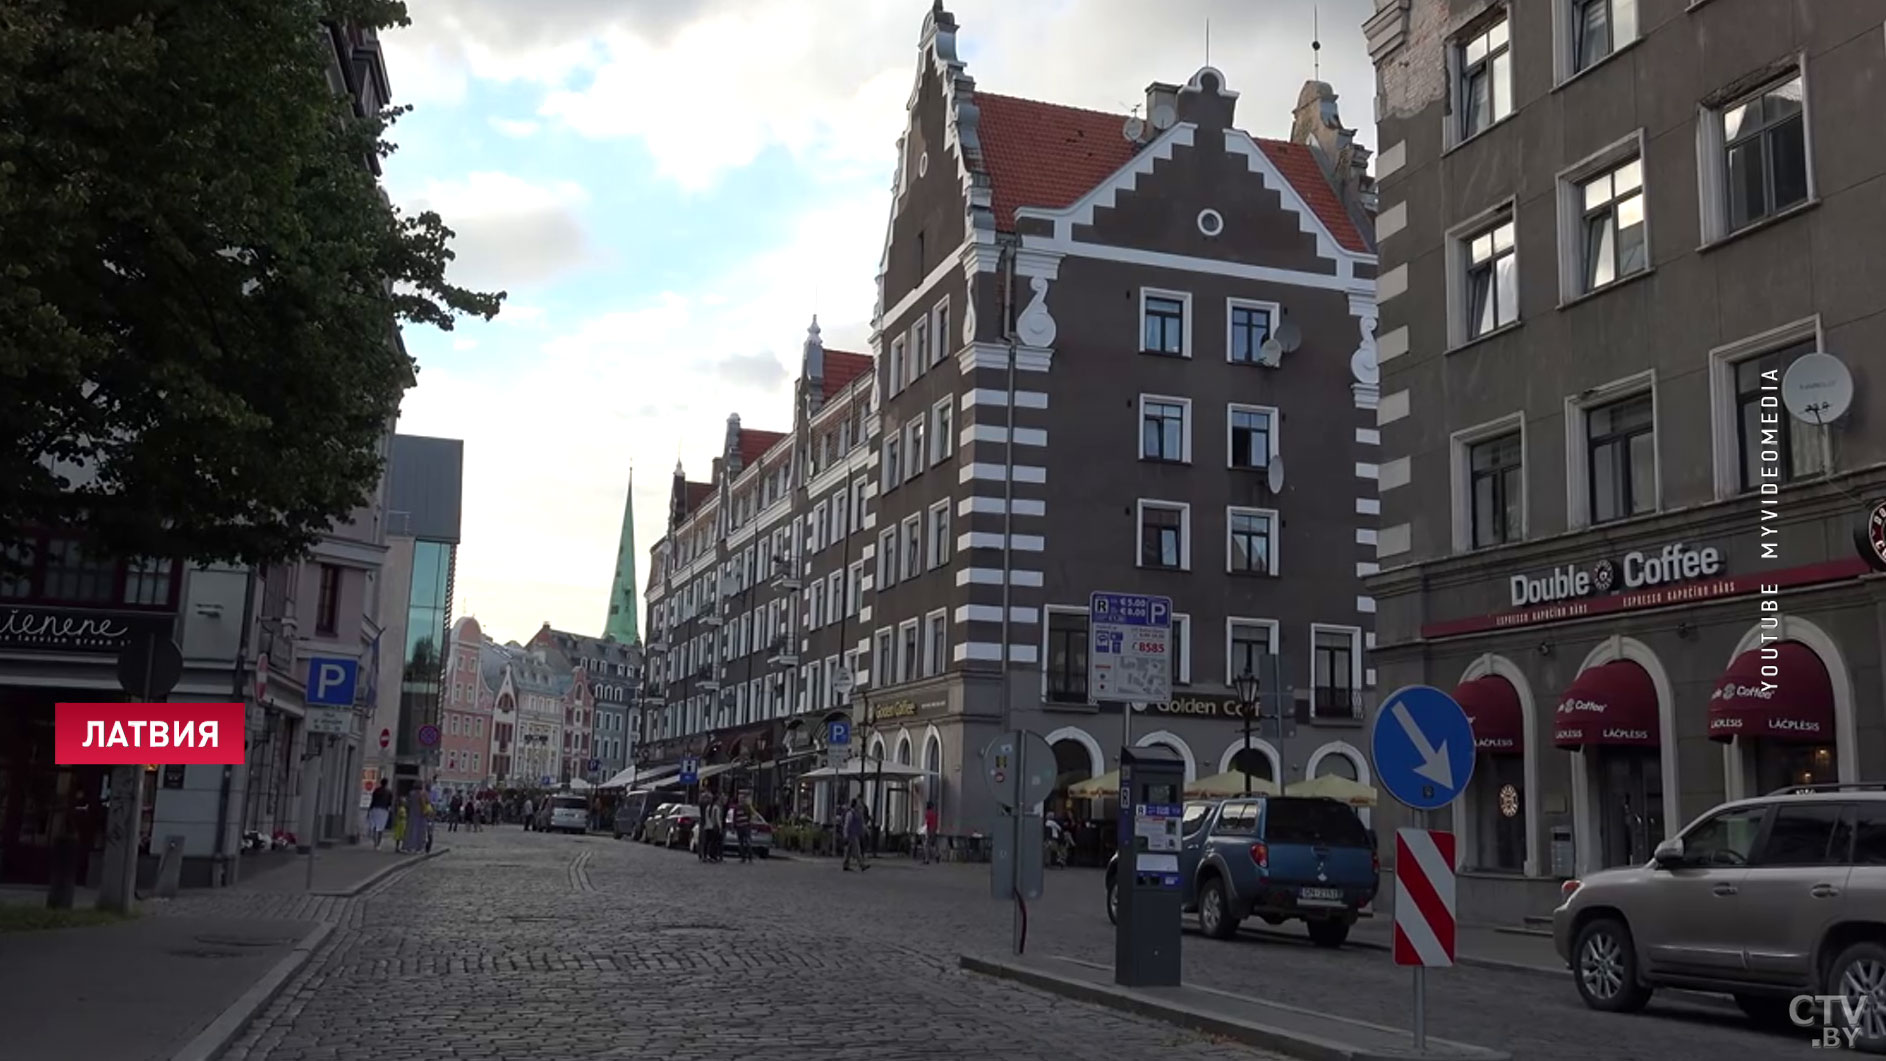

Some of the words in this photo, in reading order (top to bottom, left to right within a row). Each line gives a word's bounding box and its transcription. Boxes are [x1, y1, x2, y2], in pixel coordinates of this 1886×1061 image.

[1510, 564, 1590, 607] Double
[1624, 543, 1720, 588] Coffee
[1151, 602, 1166, 624] P
[318, 663, 346, 699] P
[833, 725, 845, 741] P
